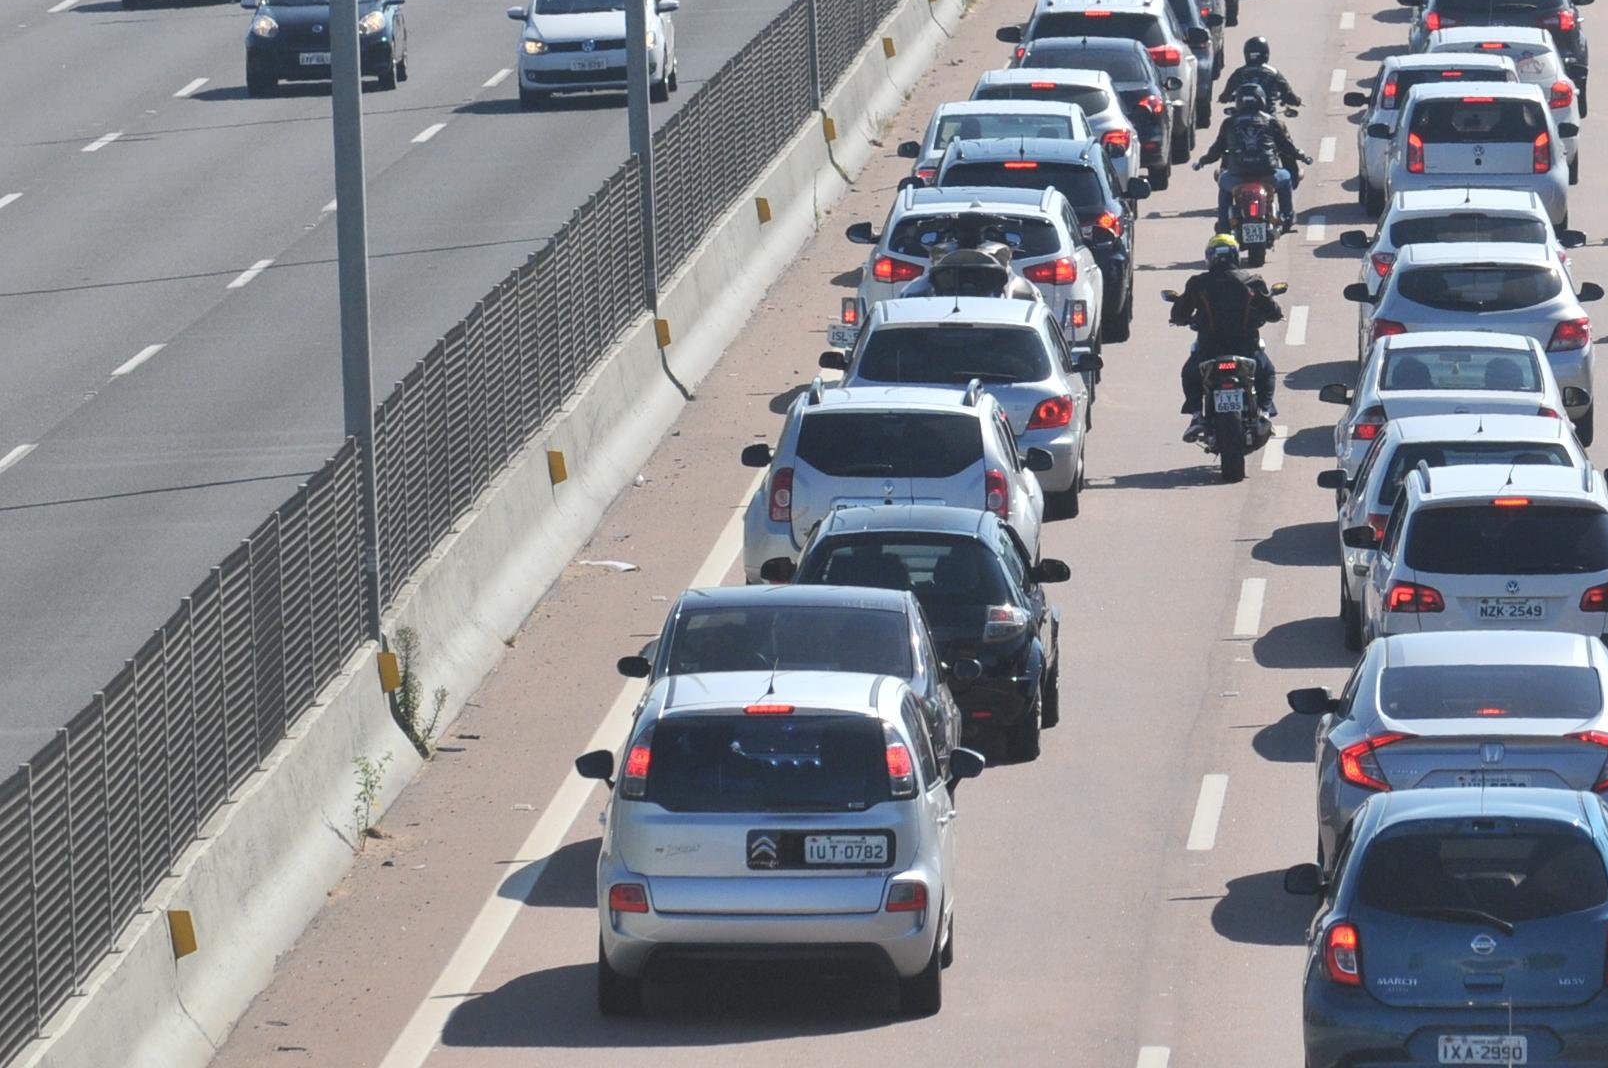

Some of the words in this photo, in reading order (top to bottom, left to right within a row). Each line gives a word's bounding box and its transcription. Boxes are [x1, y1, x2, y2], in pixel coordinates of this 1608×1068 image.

[1480, 605, 1543, 618] NZK-2549
[809, 844, 885, 861] IUT-0782
[1443, 1044, 1523, 1061] IXA-2990
